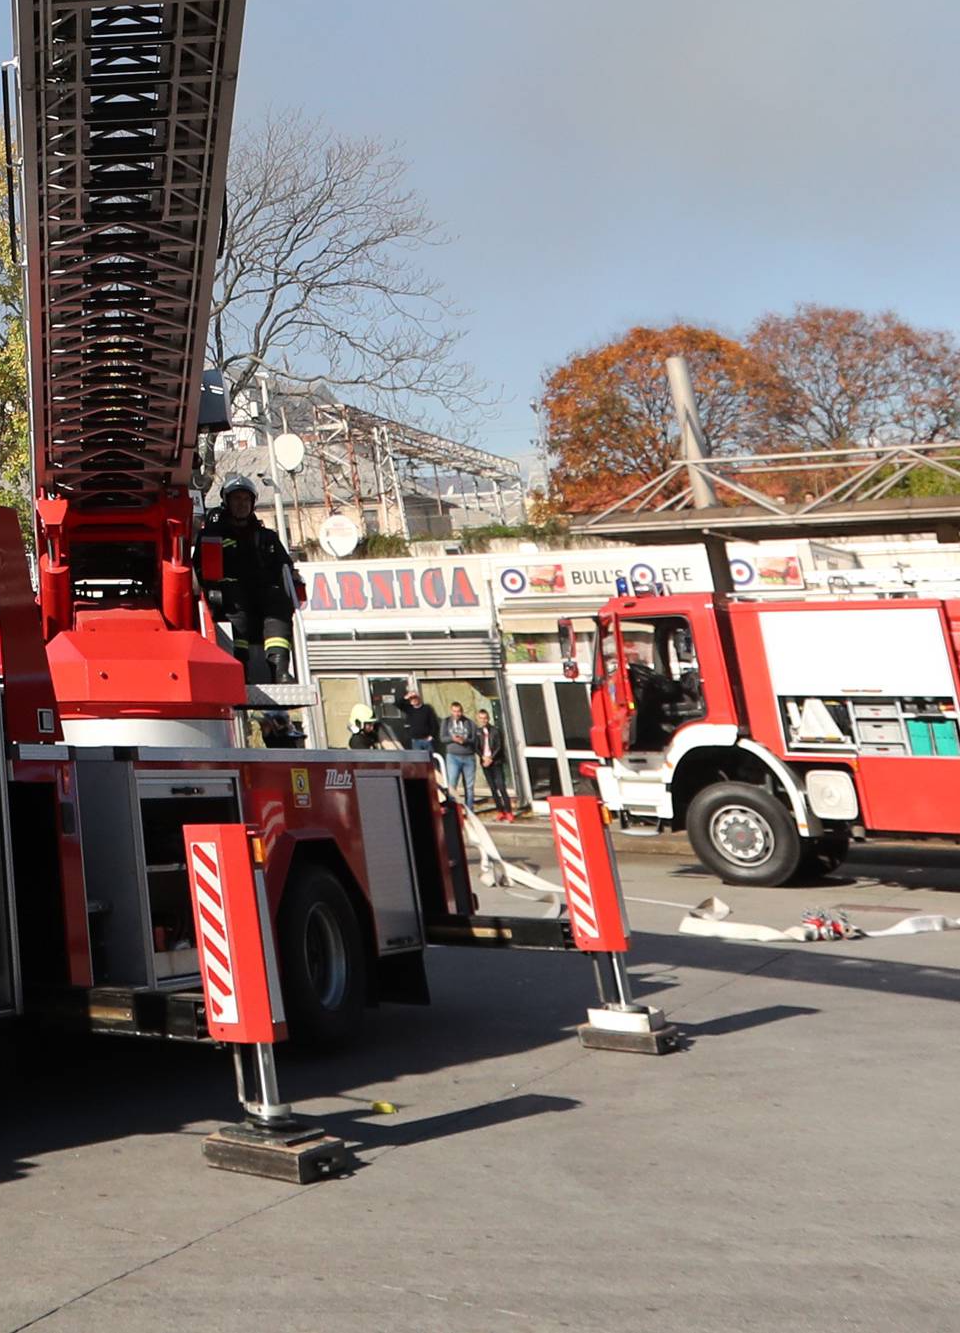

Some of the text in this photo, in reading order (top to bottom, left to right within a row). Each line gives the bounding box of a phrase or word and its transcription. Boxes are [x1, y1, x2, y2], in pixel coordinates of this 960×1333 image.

[299, 567, 480, 612] ARNICA
[571, 567, 693, 586] BULL'S EYE
